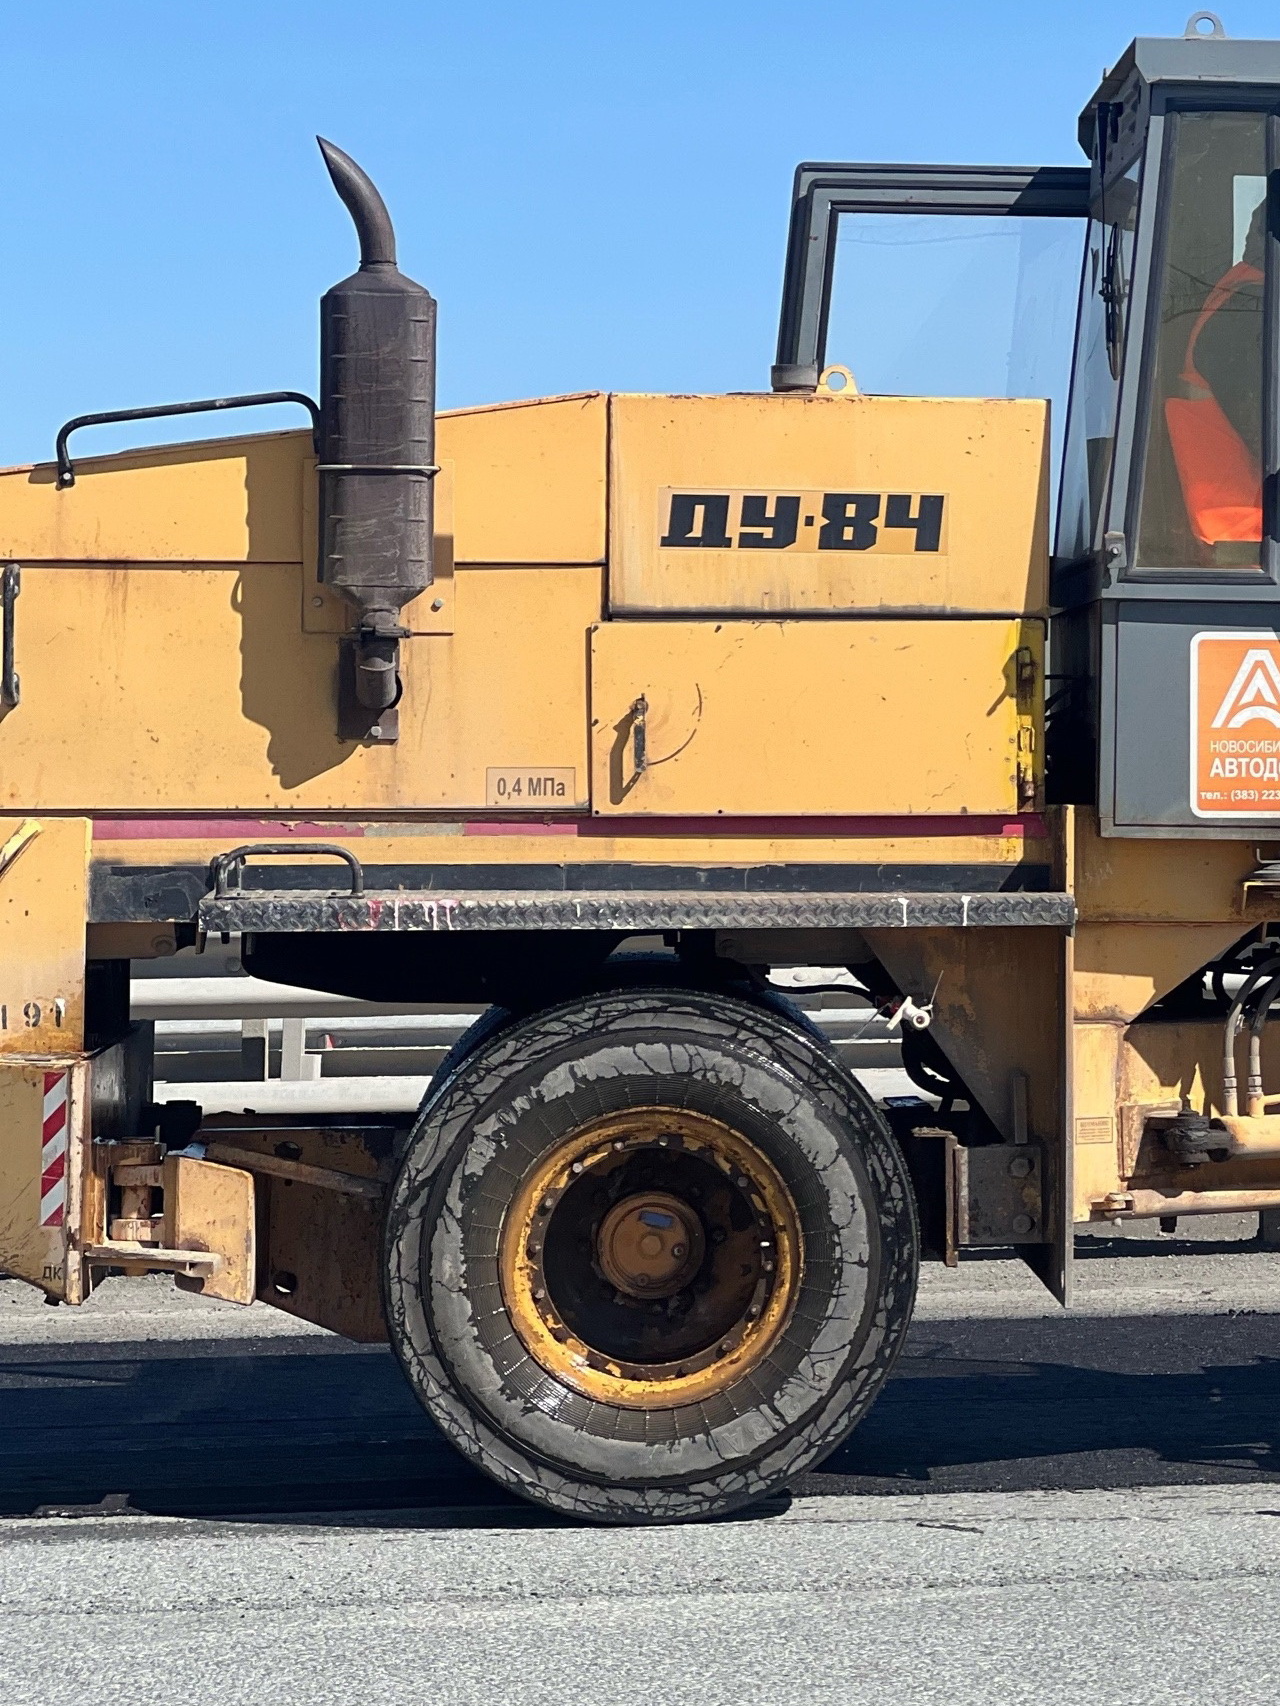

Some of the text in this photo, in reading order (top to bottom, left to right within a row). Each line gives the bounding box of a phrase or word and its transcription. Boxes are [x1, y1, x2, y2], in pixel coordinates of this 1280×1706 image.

[497, 777, 565, 800] 0,4 МПа
[1230, 789, 1259, 802] (383)
